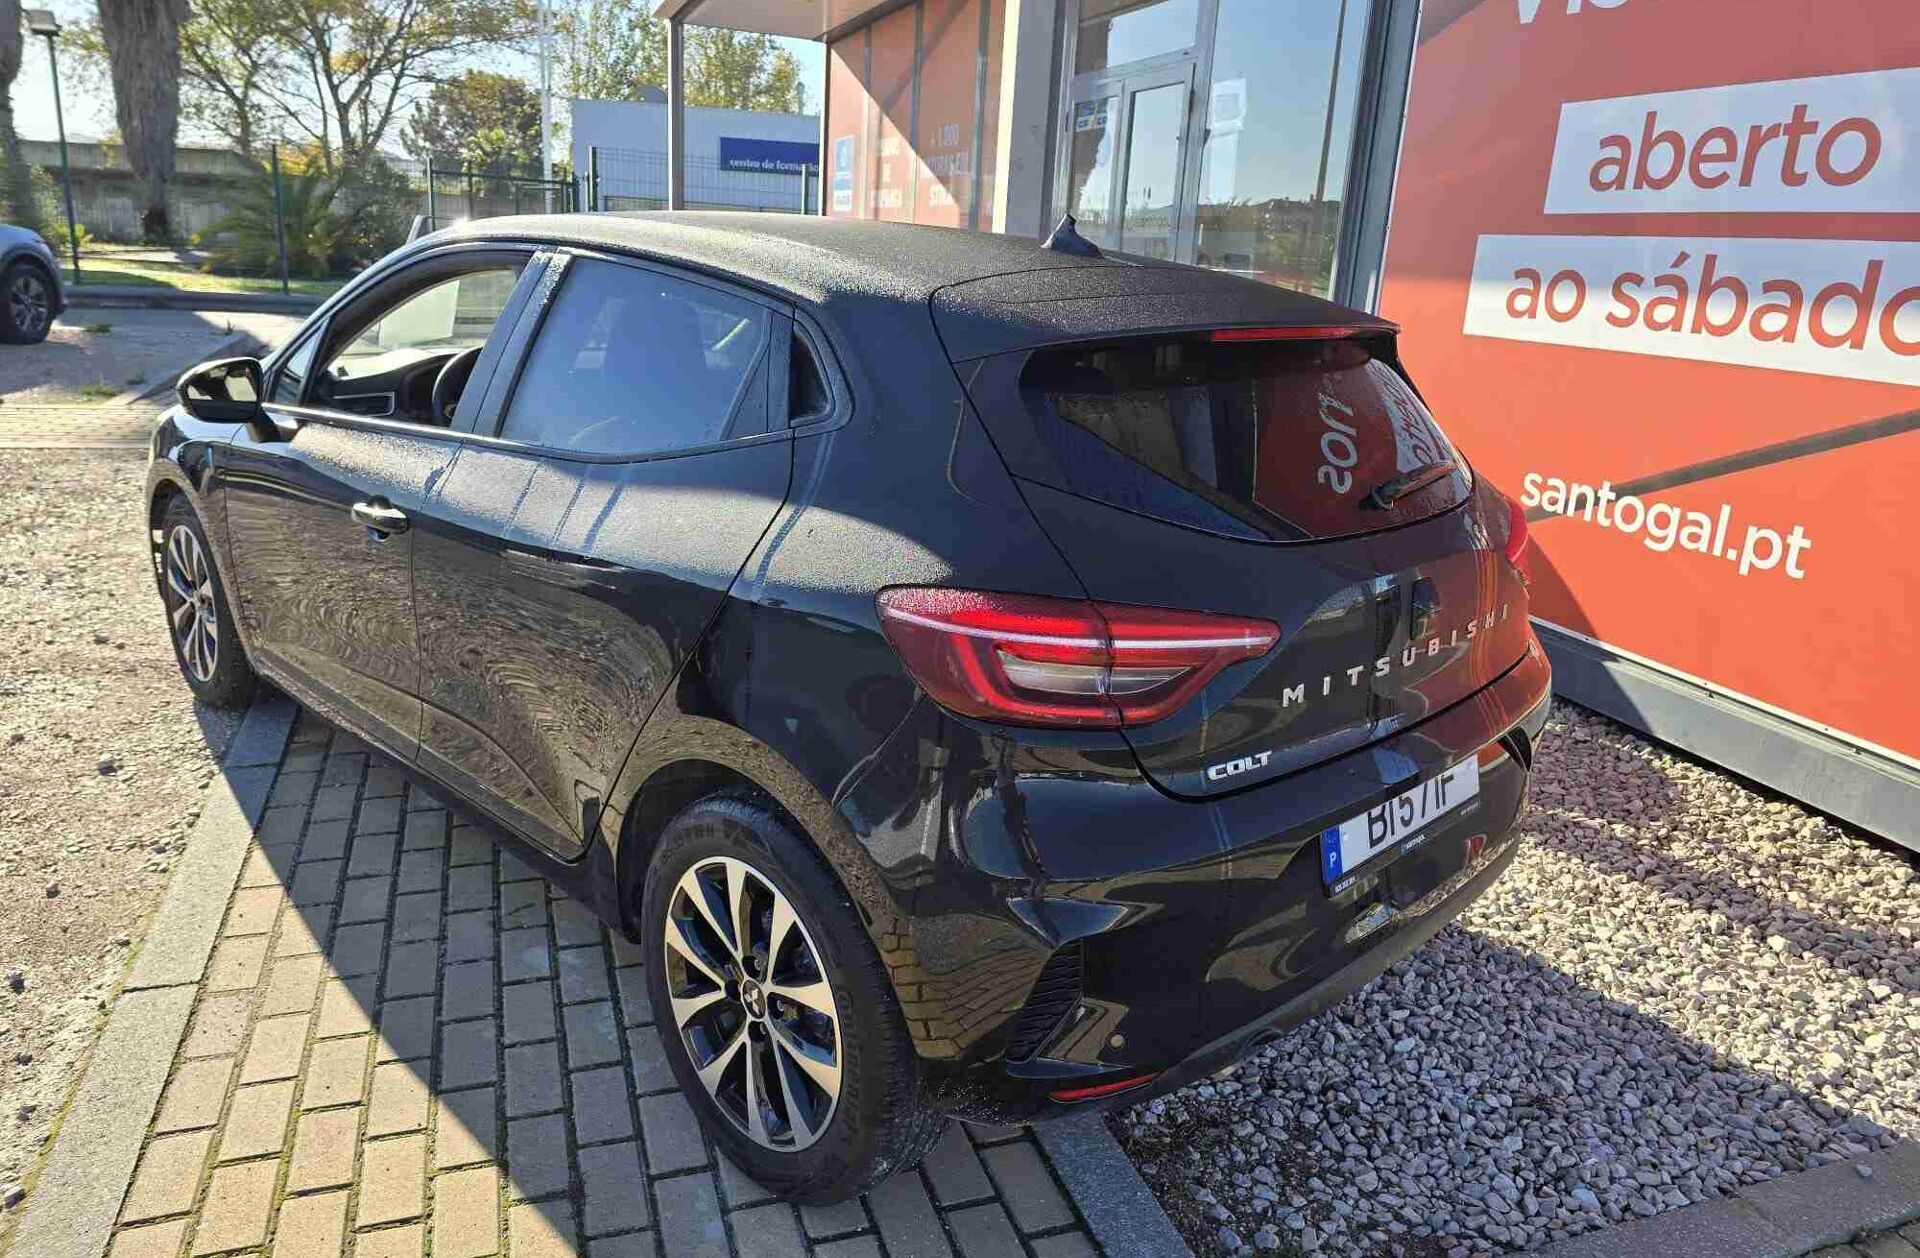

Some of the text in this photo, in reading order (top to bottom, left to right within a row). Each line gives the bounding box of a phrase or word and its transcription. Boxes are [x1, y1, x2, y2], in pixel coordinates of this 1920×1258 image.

[1588, 103, 1882, 193] aberto
[1505, 267, 1587, 323] ao
[1519, 469, 1813, 580] santogal.pt
[1282, 603, 1510, 708] MITSUBISHI
[1206, 750, 1273, 781] COLT
[1329, 851, 1337, 868] P
